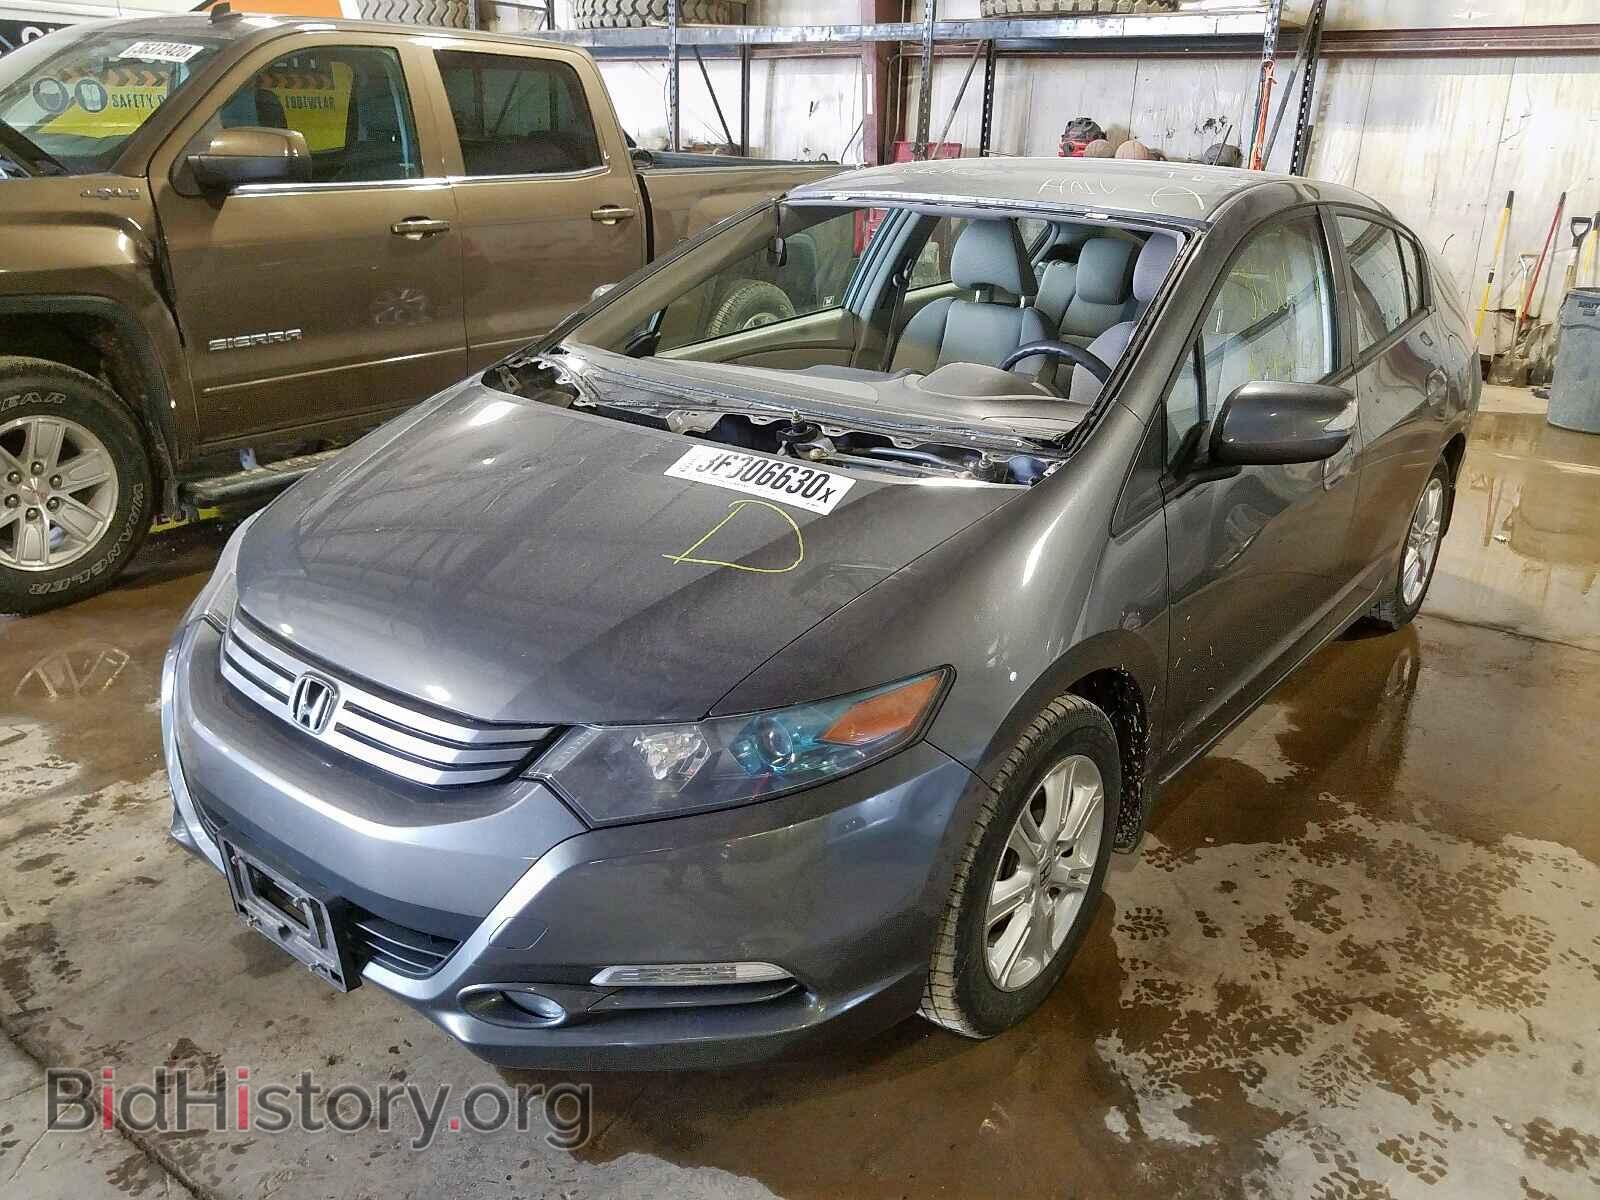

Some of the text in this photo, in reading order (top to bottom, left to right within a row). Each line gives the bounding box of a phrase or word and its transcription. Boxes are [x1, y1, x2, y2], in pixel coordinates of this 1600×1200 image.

[111, 94, 154, 108] SAFETY
[208, 328, 303, 350] SIERRA
[661, 499, 804, 573] D
